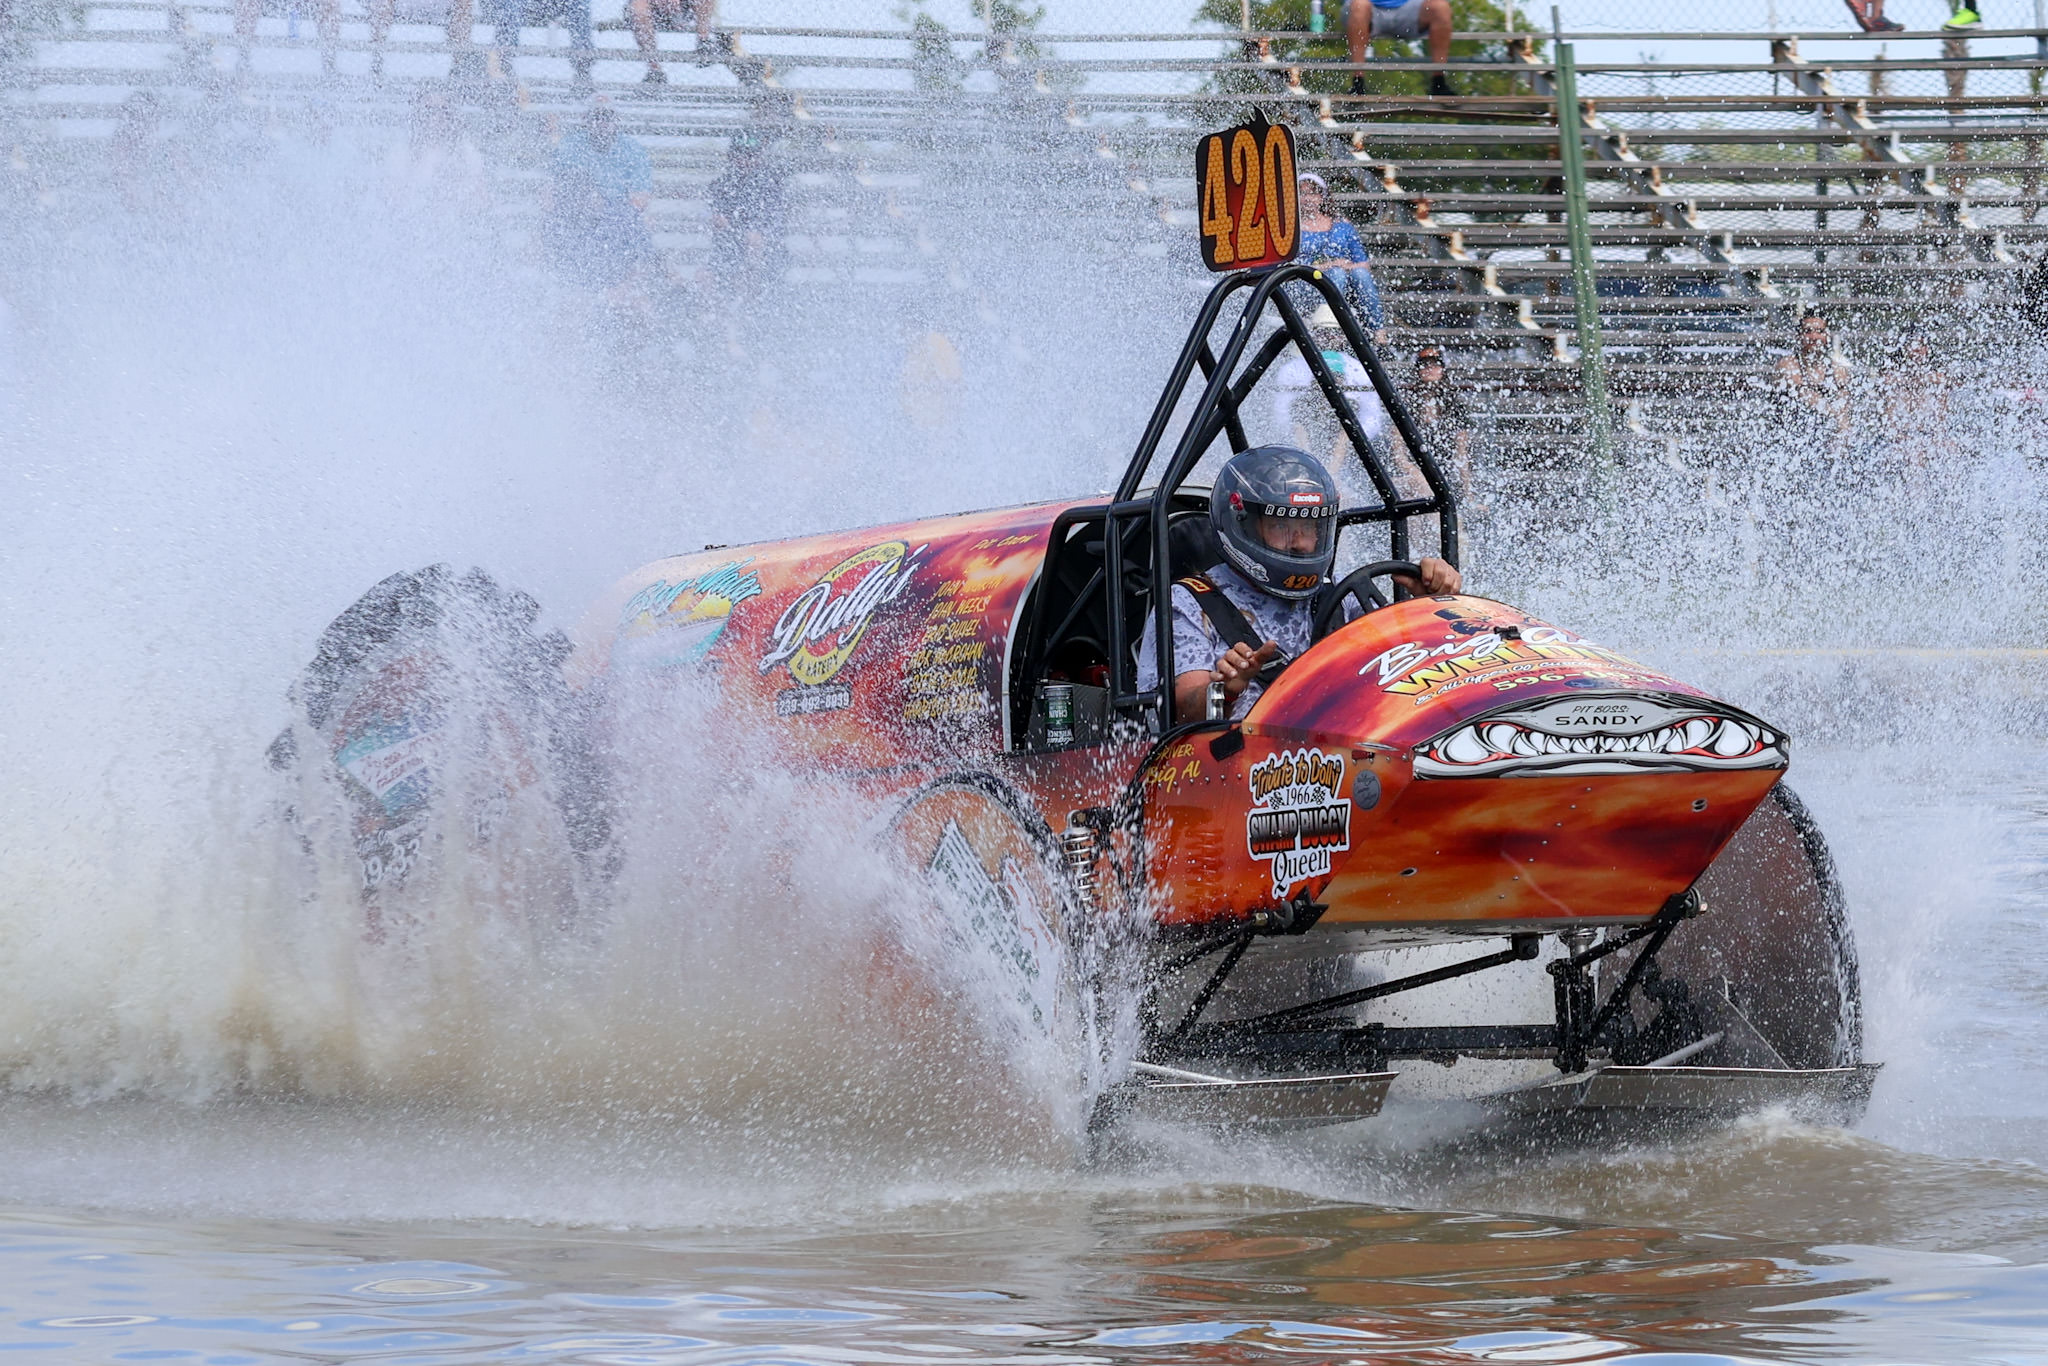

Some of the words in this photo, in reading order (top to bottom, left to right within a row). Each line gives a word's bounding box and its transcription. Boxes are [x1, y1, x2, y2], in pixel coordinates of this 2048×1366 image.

[1202, 125, 1297, 264] 420
[1283, 575, 1318, 589] 420
[759, 544, 929, 672] Dolly's
[924, 601, 958, 624] JOHN
[1358, 634, 1506, 687] Big
[1048, 709, 1067, 718] CHAIN
[1555, 716, 1643, 726] SANDY
[1572, 705, 1592, 713] PIT
[1595, 705, 1629, 713] BOSS:
[1147, 765, 1177, 793] Big
[1252, 759, 1293, 798] Tribute
[1296, 758, 1308, 783] to
[1310, 753, 1342, 798] Dolly
[1285, 787, 1310, 806] 1966
[1249, 810, 1299, 853] SWAMP
[1300, 805, 1348, 847] BUGGY
[1274, 849, 1329, 892] Queen
